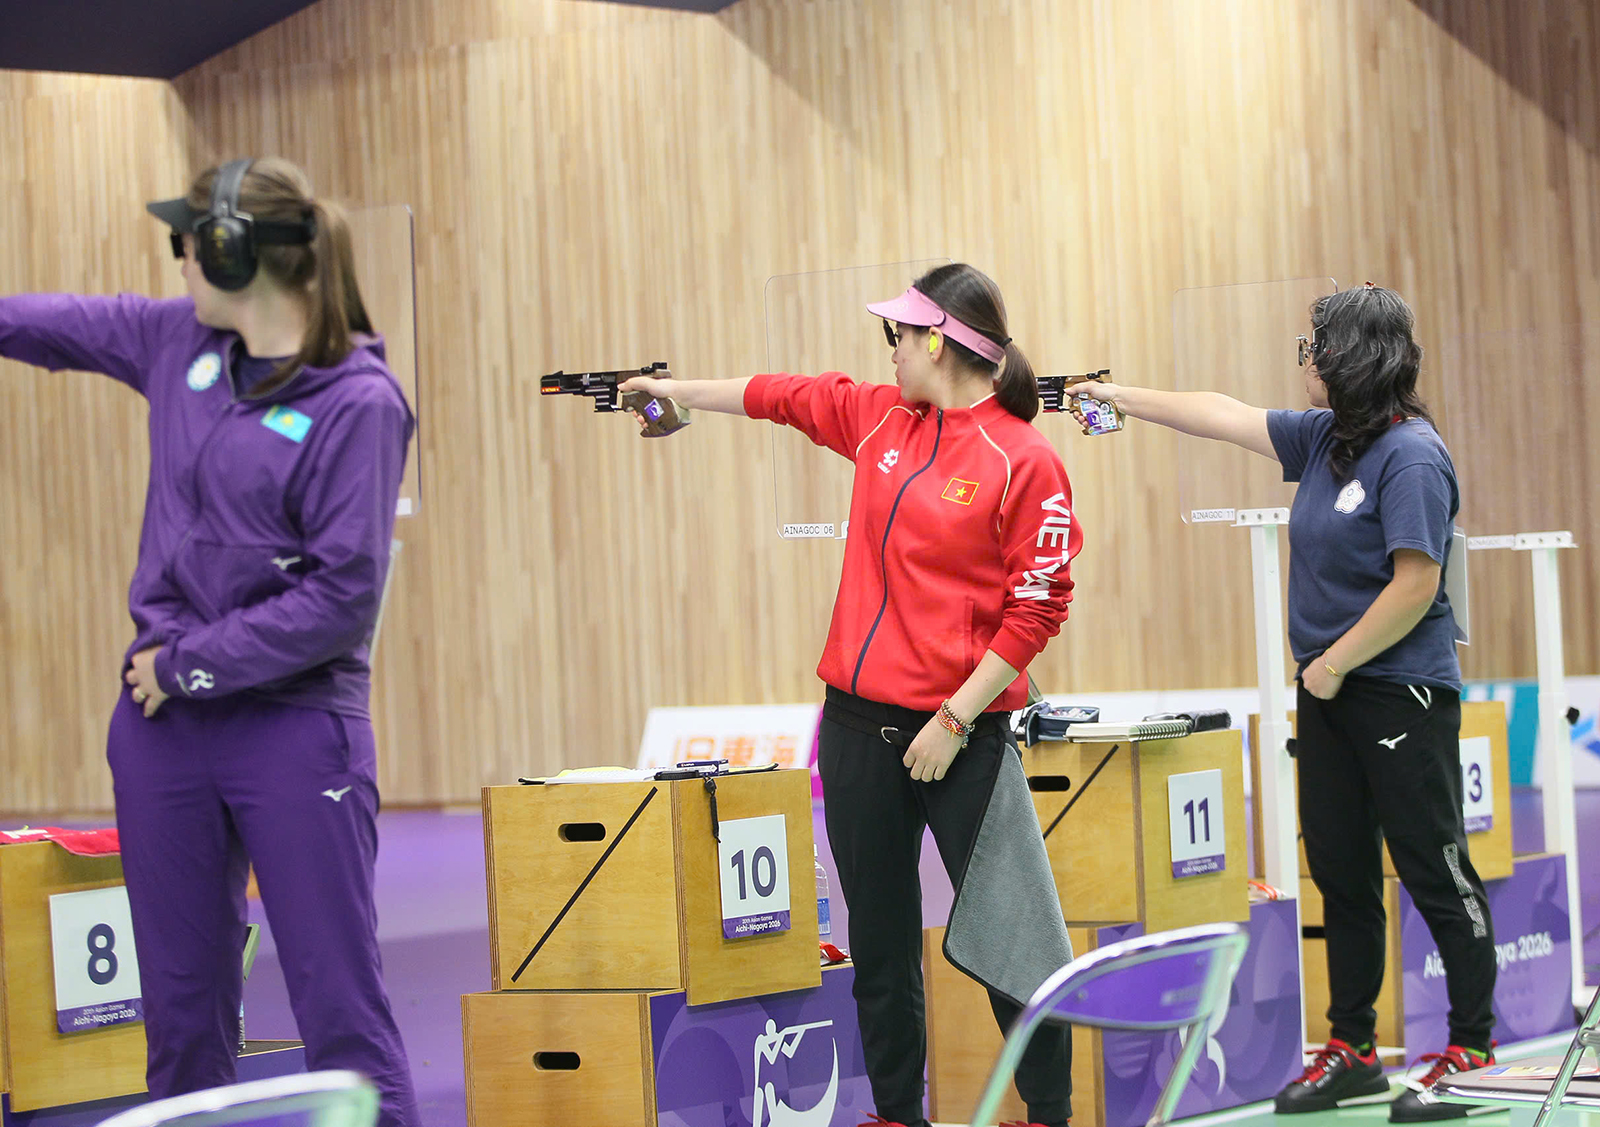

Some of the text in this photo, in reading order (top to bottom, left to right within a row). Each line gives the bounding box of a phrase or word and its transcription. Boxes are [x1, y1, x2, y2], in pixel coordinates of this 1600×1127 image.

[1192, 510, 1223, 519] AINAGOC
[784, 525, 834, 535] AINAGOC 06
[1183, 797, 1210, 844] 11
[731, 846, 777, 900] 10
[735, 920, 781, 933] Aichi-Nagoya 2026
[87, 923, 118, 985] 8
[1518, 931, 1554, 960] 2026
[73, 1009, 137, 1026] Aichi-Nagoya 2026
